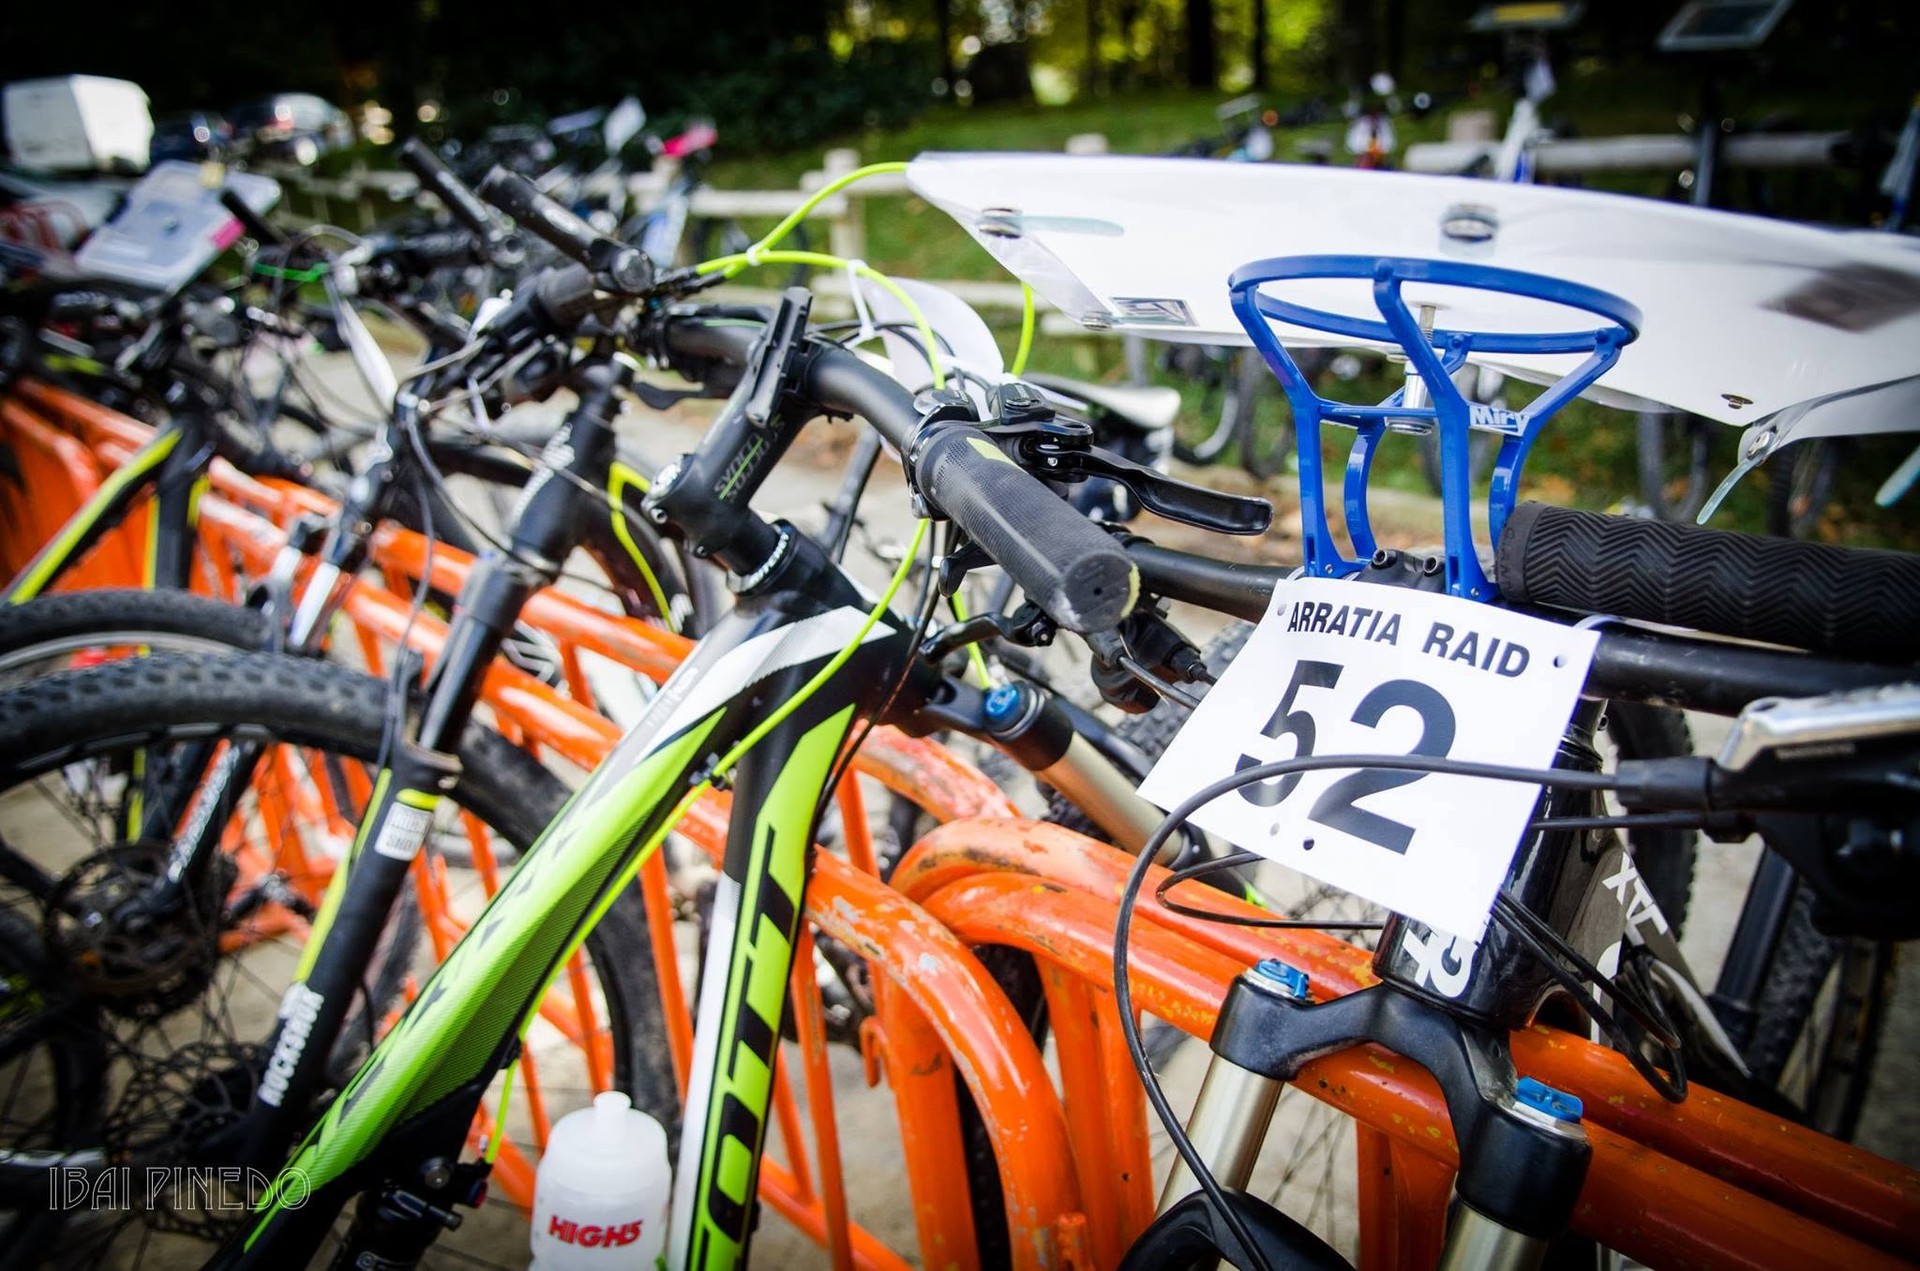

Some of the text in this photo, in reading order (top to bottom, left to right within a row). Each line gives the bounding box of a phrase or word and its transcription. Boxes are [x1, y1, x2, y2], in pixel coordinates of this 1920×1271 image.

[1287, 601, 1531, 678] ARRATIA RAID
[1234, 659, 1457, 856] 52
[1602, 852, 1669, 946] XTC
[694, 825, 796, 1271] OTT
[547, 1214, 644, 1249] HIGH5
